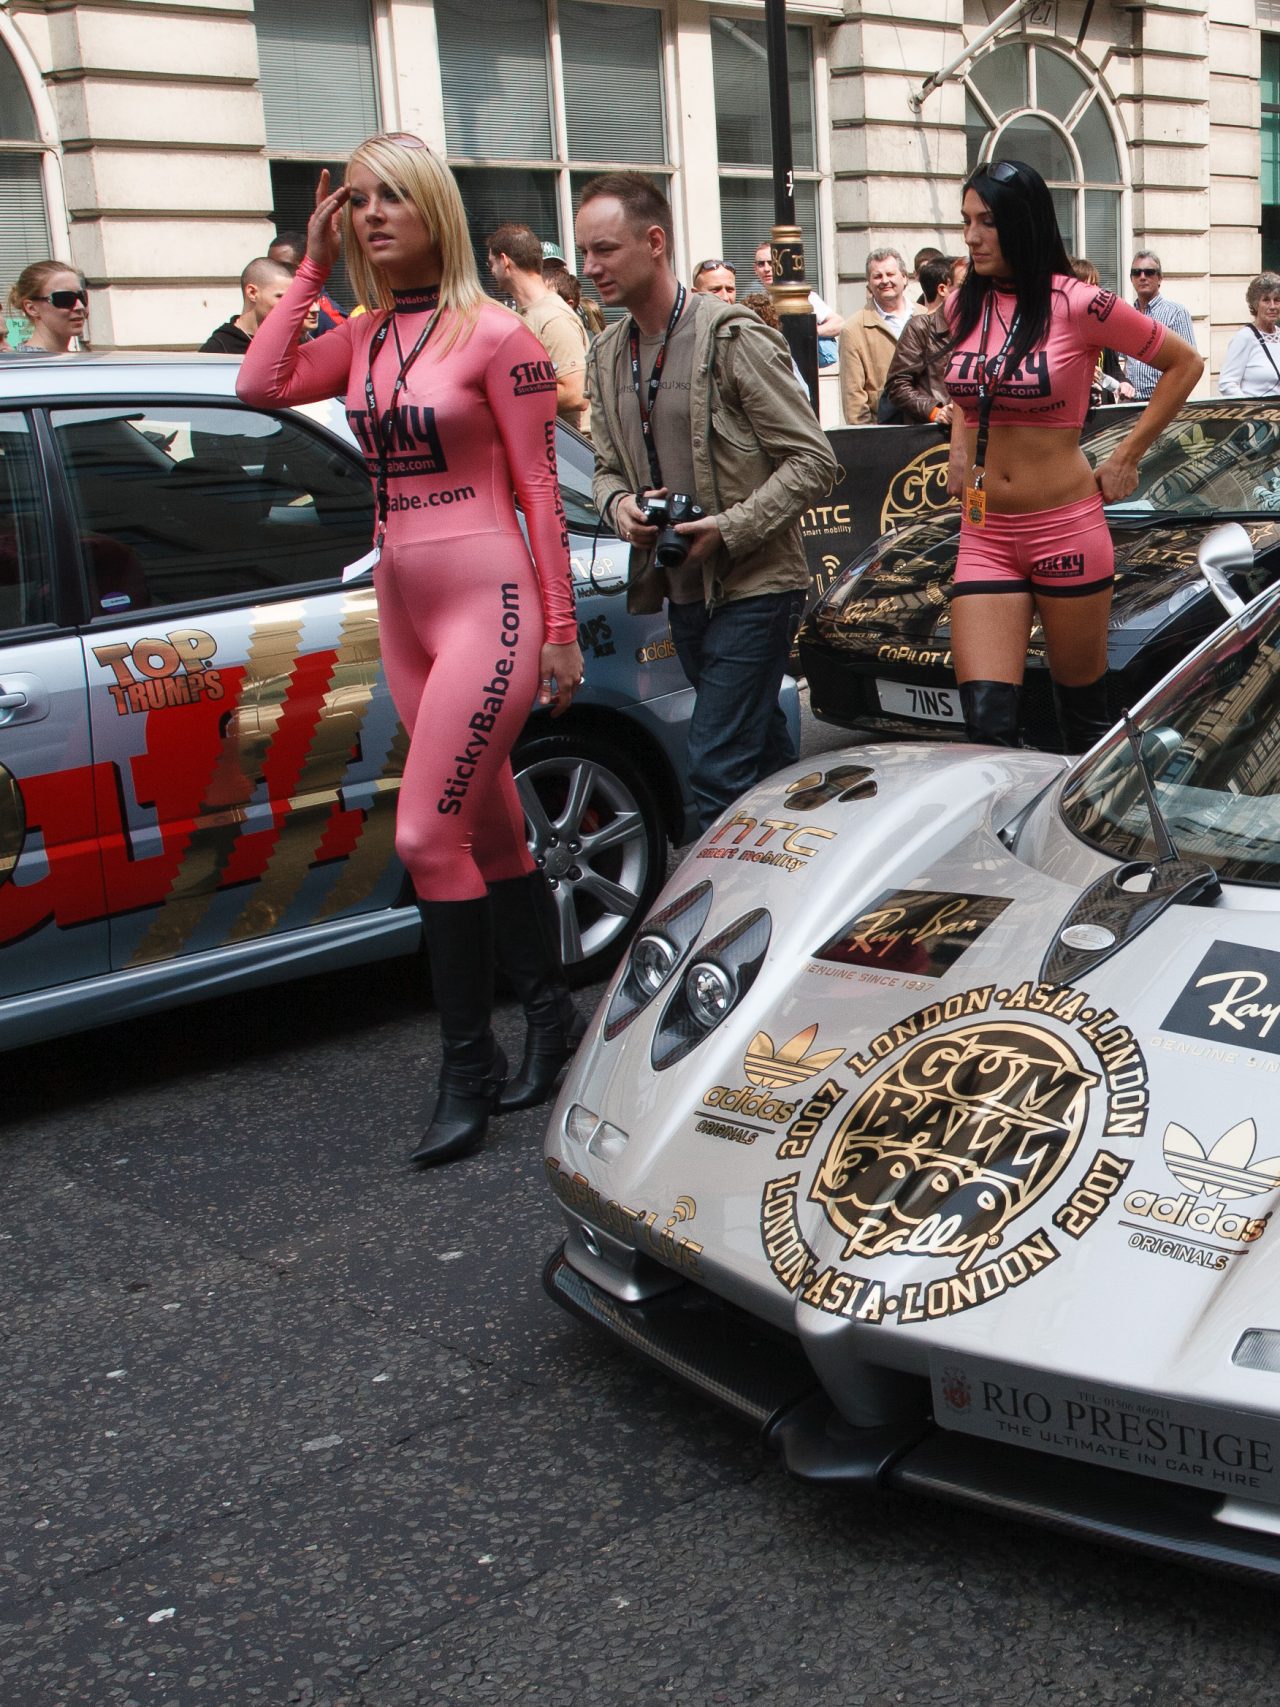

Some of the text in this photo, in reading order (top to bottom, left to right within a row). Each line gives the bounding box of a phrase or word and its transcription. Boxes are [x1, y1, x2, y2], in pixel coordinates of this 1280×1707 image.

[107, 670, 225, 717] TRUMPS
[437, 582, 520, 816] StickyBabe.com
[696, 847, 808, 873] smart mobility
[857, 971, 900, 988] SINCE
[1148, 1035, 1241, 1066] GENUINE
[702, 1085, 797, 1124] adidas
[775, 1078, 849, 1160] 2007
[694, 1119, 760, 1146] ORIGINALS
[1051, 1148, 1135, 1240] 2007
[1123, 1189, 1269, 1243] adidas
[1127, 1232, 1230, 1271] ORIGINALS
[980, 1379, 1275, 1475] RIO PRESTIGE
[995, 1418, 1261, 1489] THE ULTIMATE IN CAR HIRE
